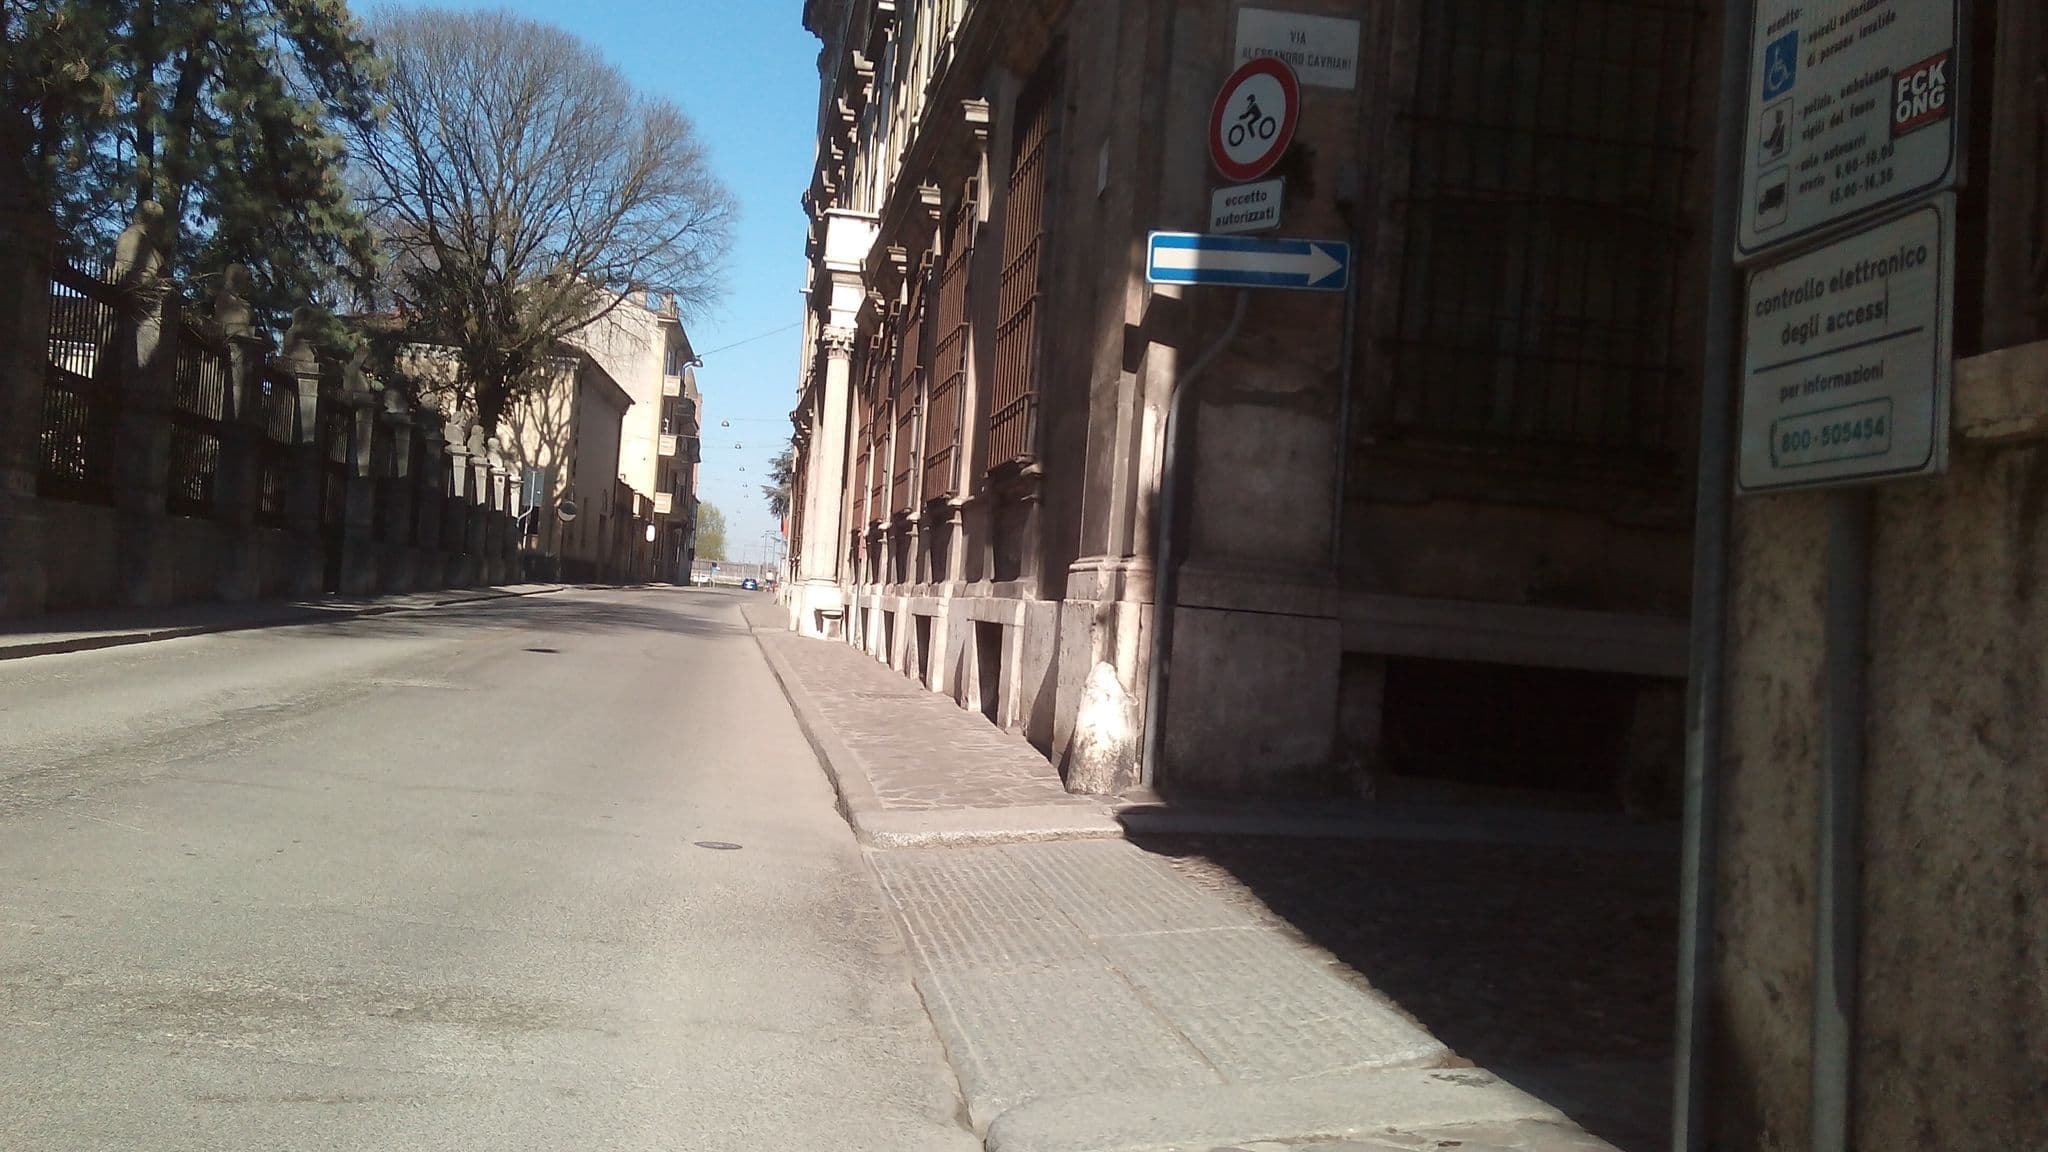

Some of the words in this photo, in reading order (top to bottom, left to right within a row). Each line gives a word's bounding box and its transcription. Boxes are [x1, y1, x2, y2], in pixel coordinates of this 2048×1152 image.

[1290, 30, 1307, 45] VIA
[1898, 58, 1948, 105] FCK
[1896, 84, 1947, 124] ONG
[1215, 206, 1275, 226] autorizzati
[1225, 190, 1267, 207] eccetto
[1756, 276, 1826, 318] controllo
[1829, 244, 1928, 293] elettronico
[1782, 312, 1820, 346] degli
[1826, 300, 1889, 334] accessi
[1779, 384, 1800, 404] per
[1803, 359, 1885, 394] informazioni
